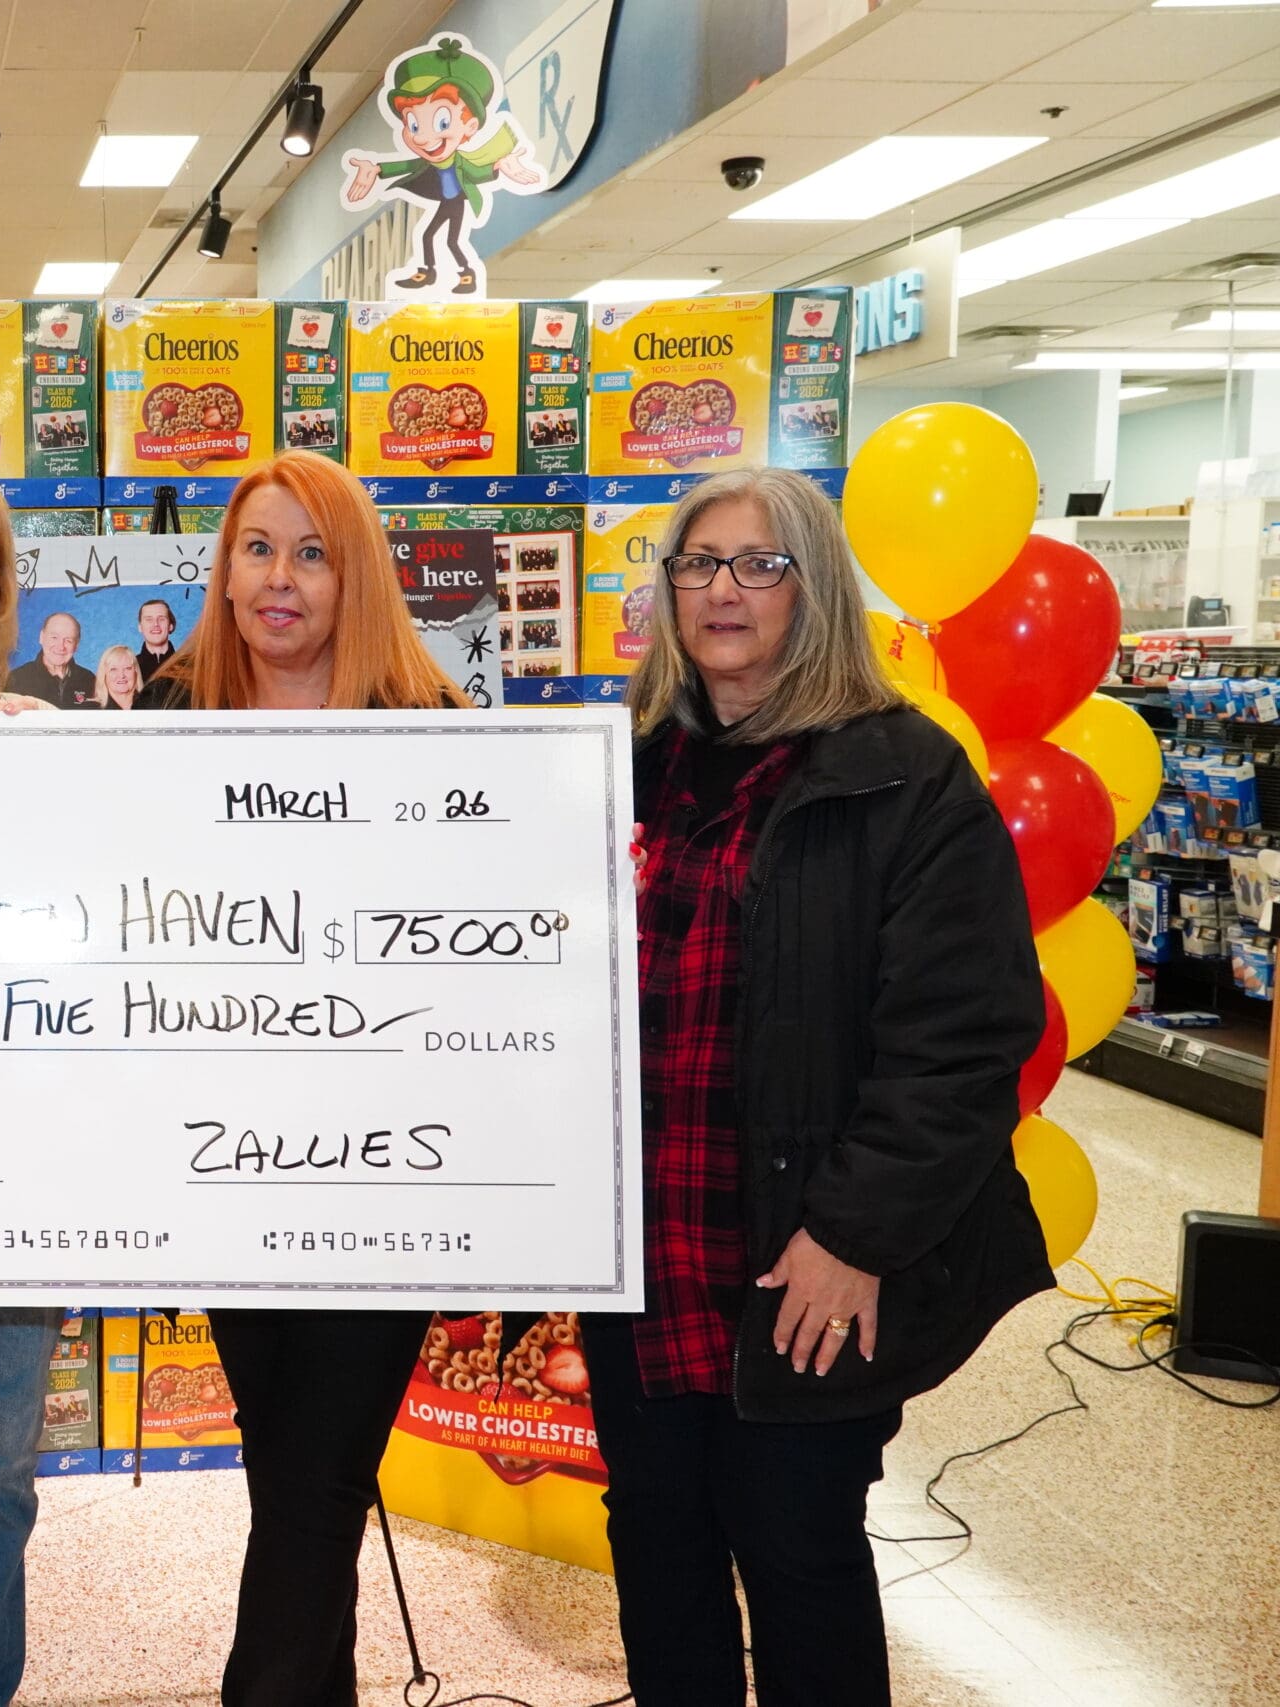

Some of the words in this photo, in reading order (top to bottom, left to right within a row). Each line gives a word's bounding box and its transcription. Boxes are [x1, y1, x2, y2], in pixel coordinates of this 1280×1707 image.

[144, 332, 240, 361] Cheerios
[390, 334, 484, 362] Cheerios
[634, 332, 733, 361] Cheerios
[207, 367, 231, 375] OATS
[698, 362, 724, 372] OATS
[300, 394, 322, 406] 2026
[543, 394, 564, 406] 2026
[799, 386, 824, 398] 2026
[50, 396, 72, 408] 2026
[141, 444, 172, 453] LOWER
[173, 439, 233, 452] CHOLESTEROL
[386, 444, 417, 453] LOWER
[418, 439, 477, 452] CHOLESTEROL
[627, 442, 660, 452] LOWER
[661, 435, 725, 450] CHOLESTEROL
[536, 459, 569, 473] Together
[417, 513, 438, 521] CLASS
[415, 537, 464, 565] give
[422, 565, 484, 587] here.
[403, 593, 434, 602] Hunger
[225, 782, 348, 821] MARCH
[394, 802, 426, 822] 20
[445, 789, 490, 819] 26
[120, 877, 301, 956] HAVEN
[323, 918, 345, 964] $
[4, 978, 94, 1042] FIVE
[124, 980, 367, 1038] HUNDRED
[425, 1031, 557, 1053] DOLLARS
[184, 1121, 451, 1173] ZALLIES
[55, 1378, 76, 1390] 2026
[172, 1411, 228, 1425] CHOLESTEROL
[478, 1399, 509, 1416] CAN
[513, 1403, 553, 1420] HELP
[408, 1399, 478, 1432] LOWER
[482, 1416, 599, 1449] CHOLESTER
[441, 1429, 452, 1441] AS
[455, 1432, 475, 1446] PART
[478, 1435, 489, 1447] OF
[491, 1437, 497, 1448] A
[499, 1438, 527, 1452] HEART
[529, 1442, 568, 1457] HEALTHY
[570, 1449, 590, 1462] DIET
